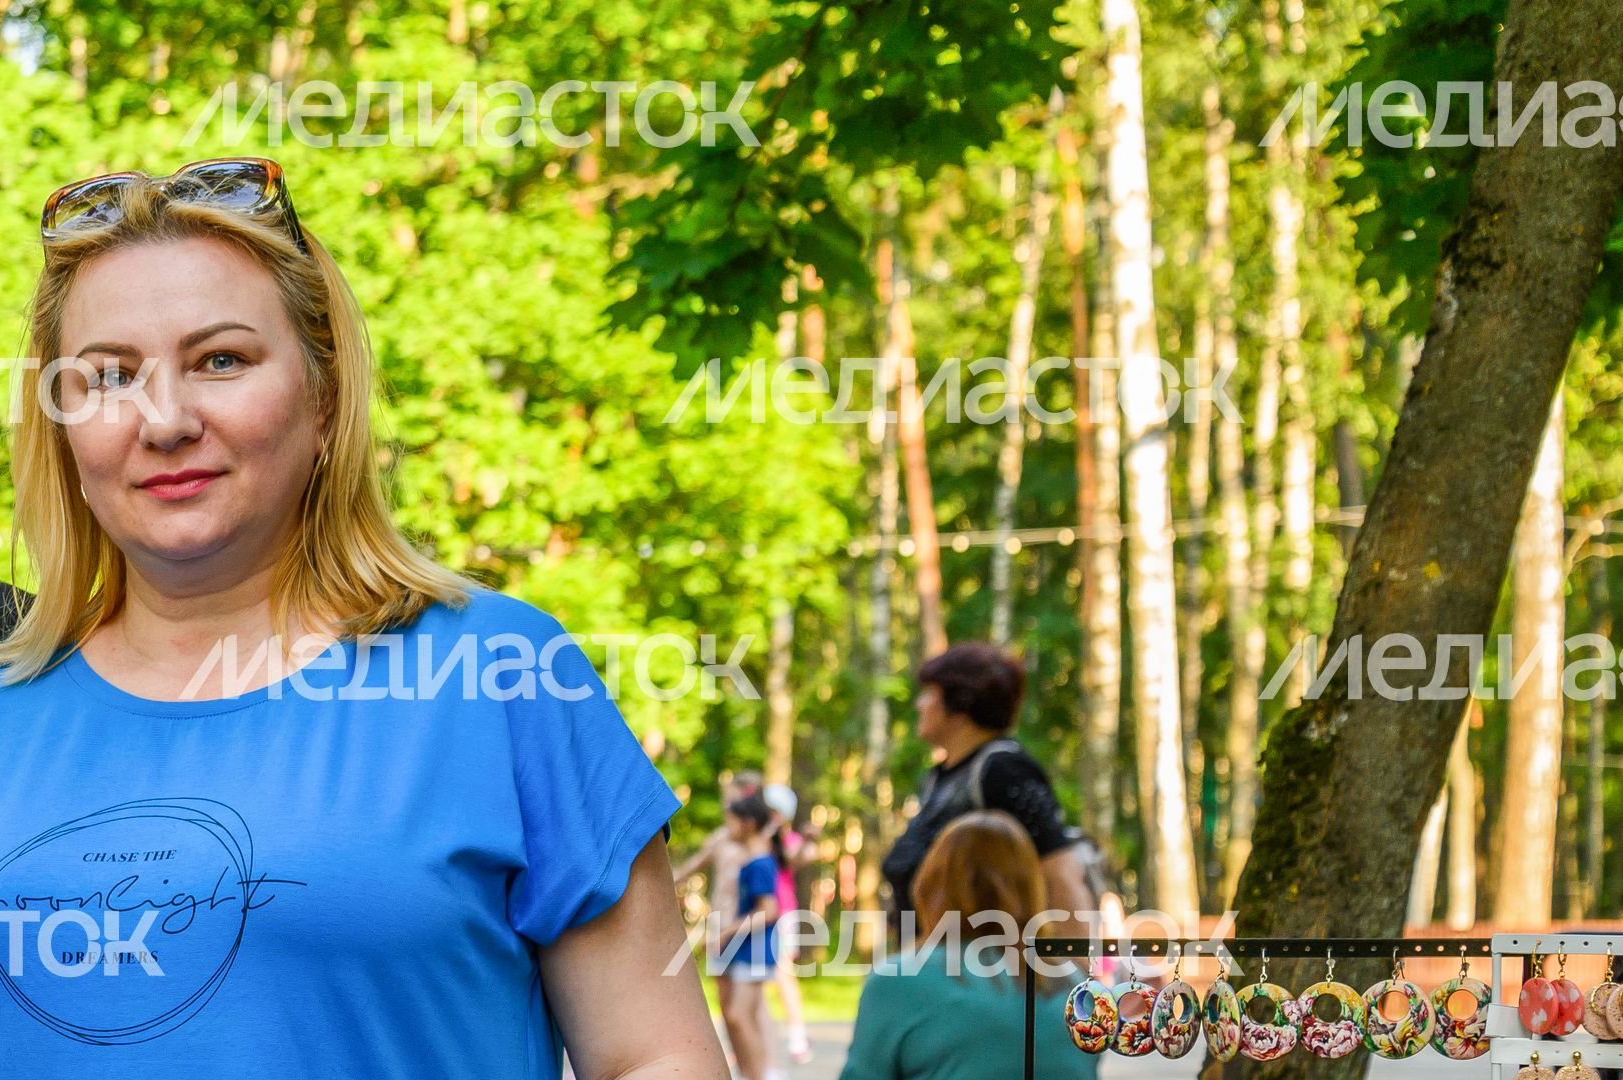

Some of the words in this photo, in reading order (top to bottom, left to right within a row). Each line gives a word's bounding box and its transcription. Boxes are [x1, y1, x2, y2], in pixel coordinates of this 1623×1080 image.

[82, 850, 138, 863] CHASE
[143, 850, 177, 862] THE
[61, 951, 159, 965] DREAMERS
